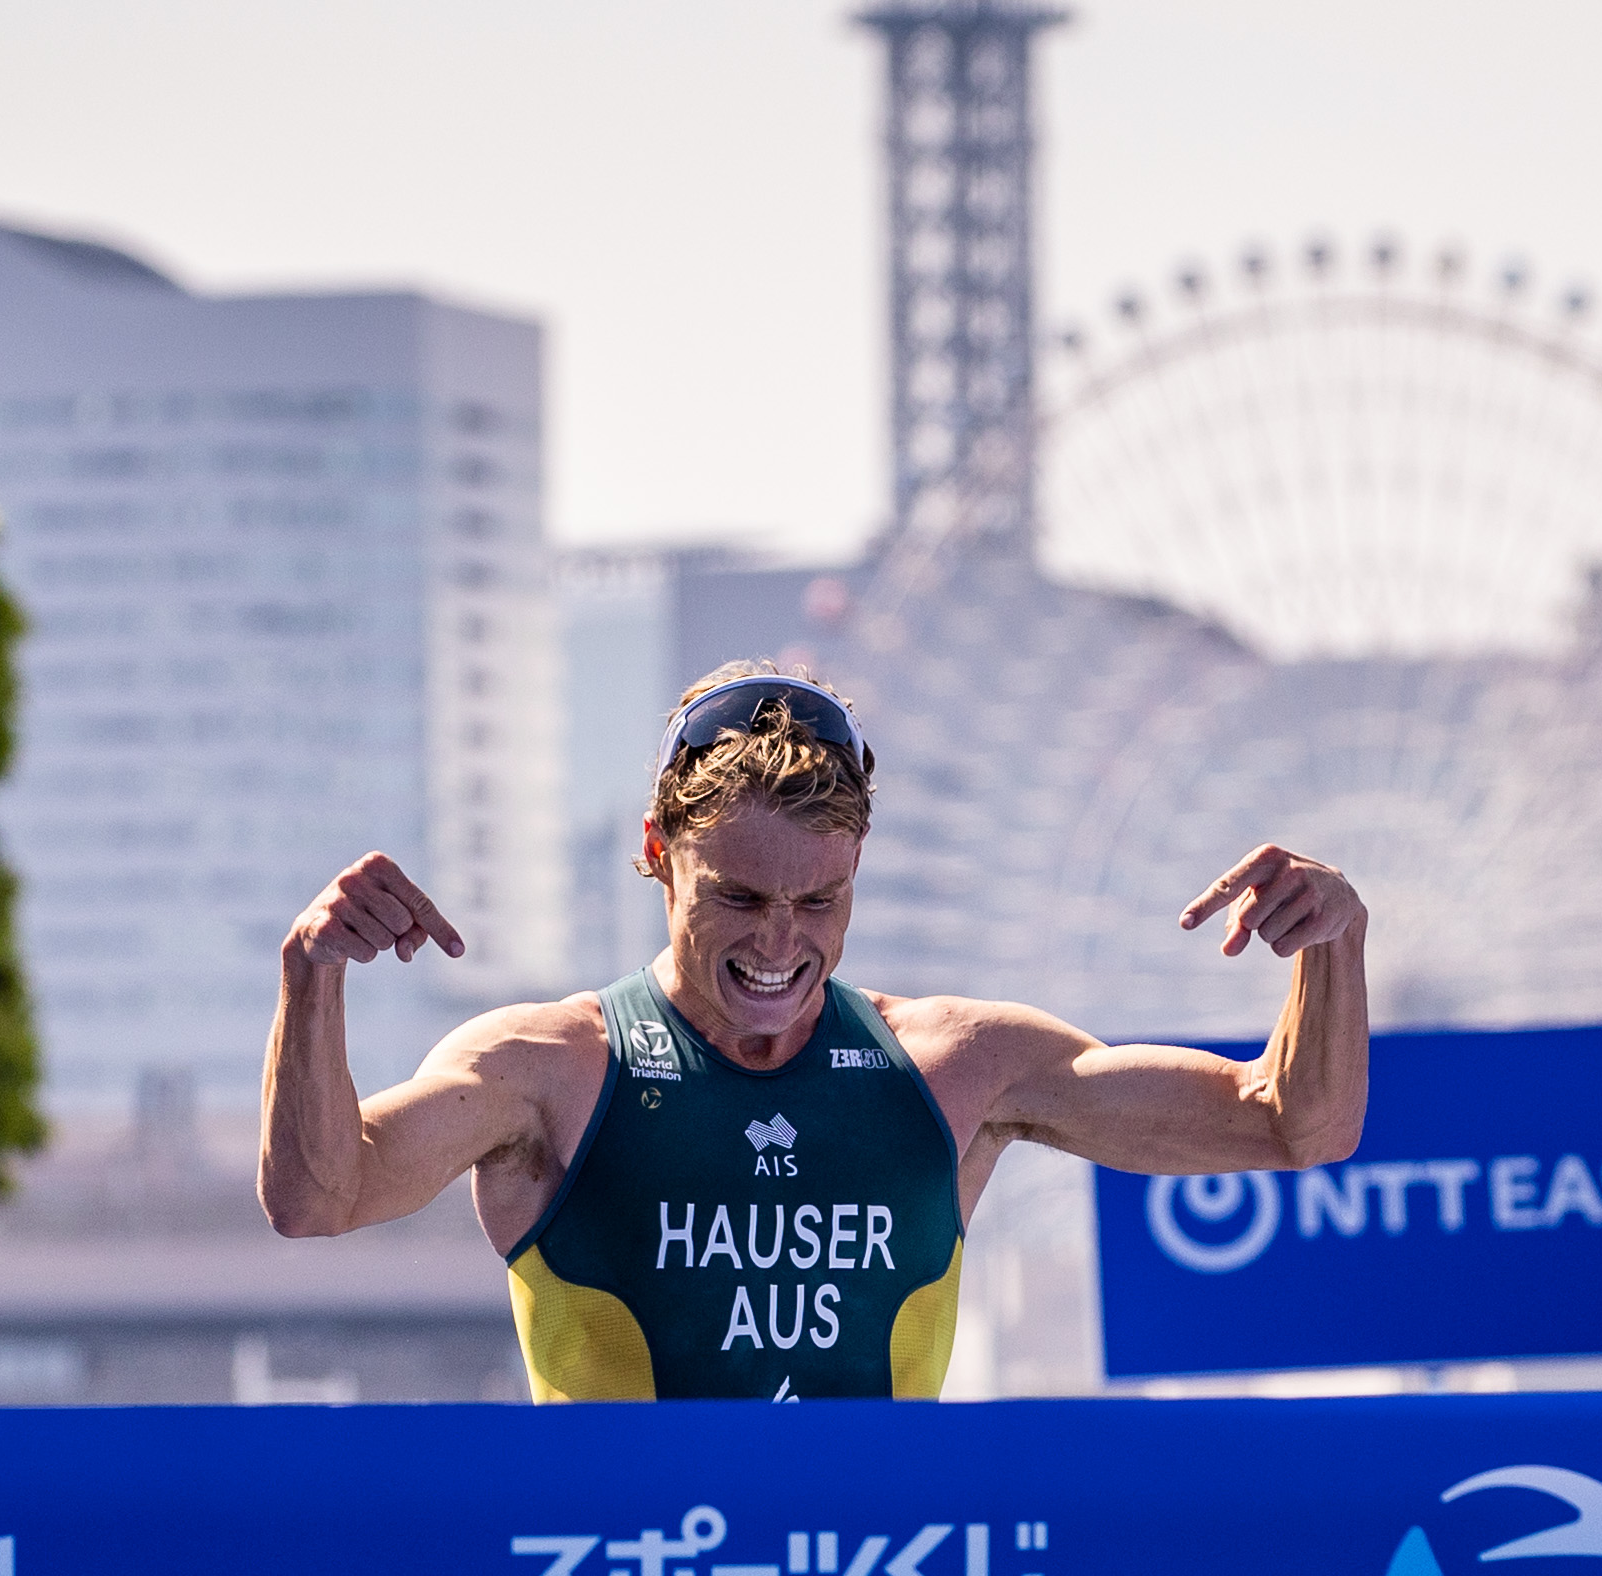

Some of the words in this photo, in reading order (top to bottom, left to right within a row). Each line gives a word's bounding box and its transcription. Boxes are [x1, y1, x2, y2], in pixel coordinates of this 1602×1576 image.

[629, 1066, 682, 1081] Triathlon
[637, 1056, 673, 1070] World
[754, 1154, 798, 1177] AIS
[655, 1201, 896, 1270] HAUSER
[720, 1283, 842, 1351] AUS
